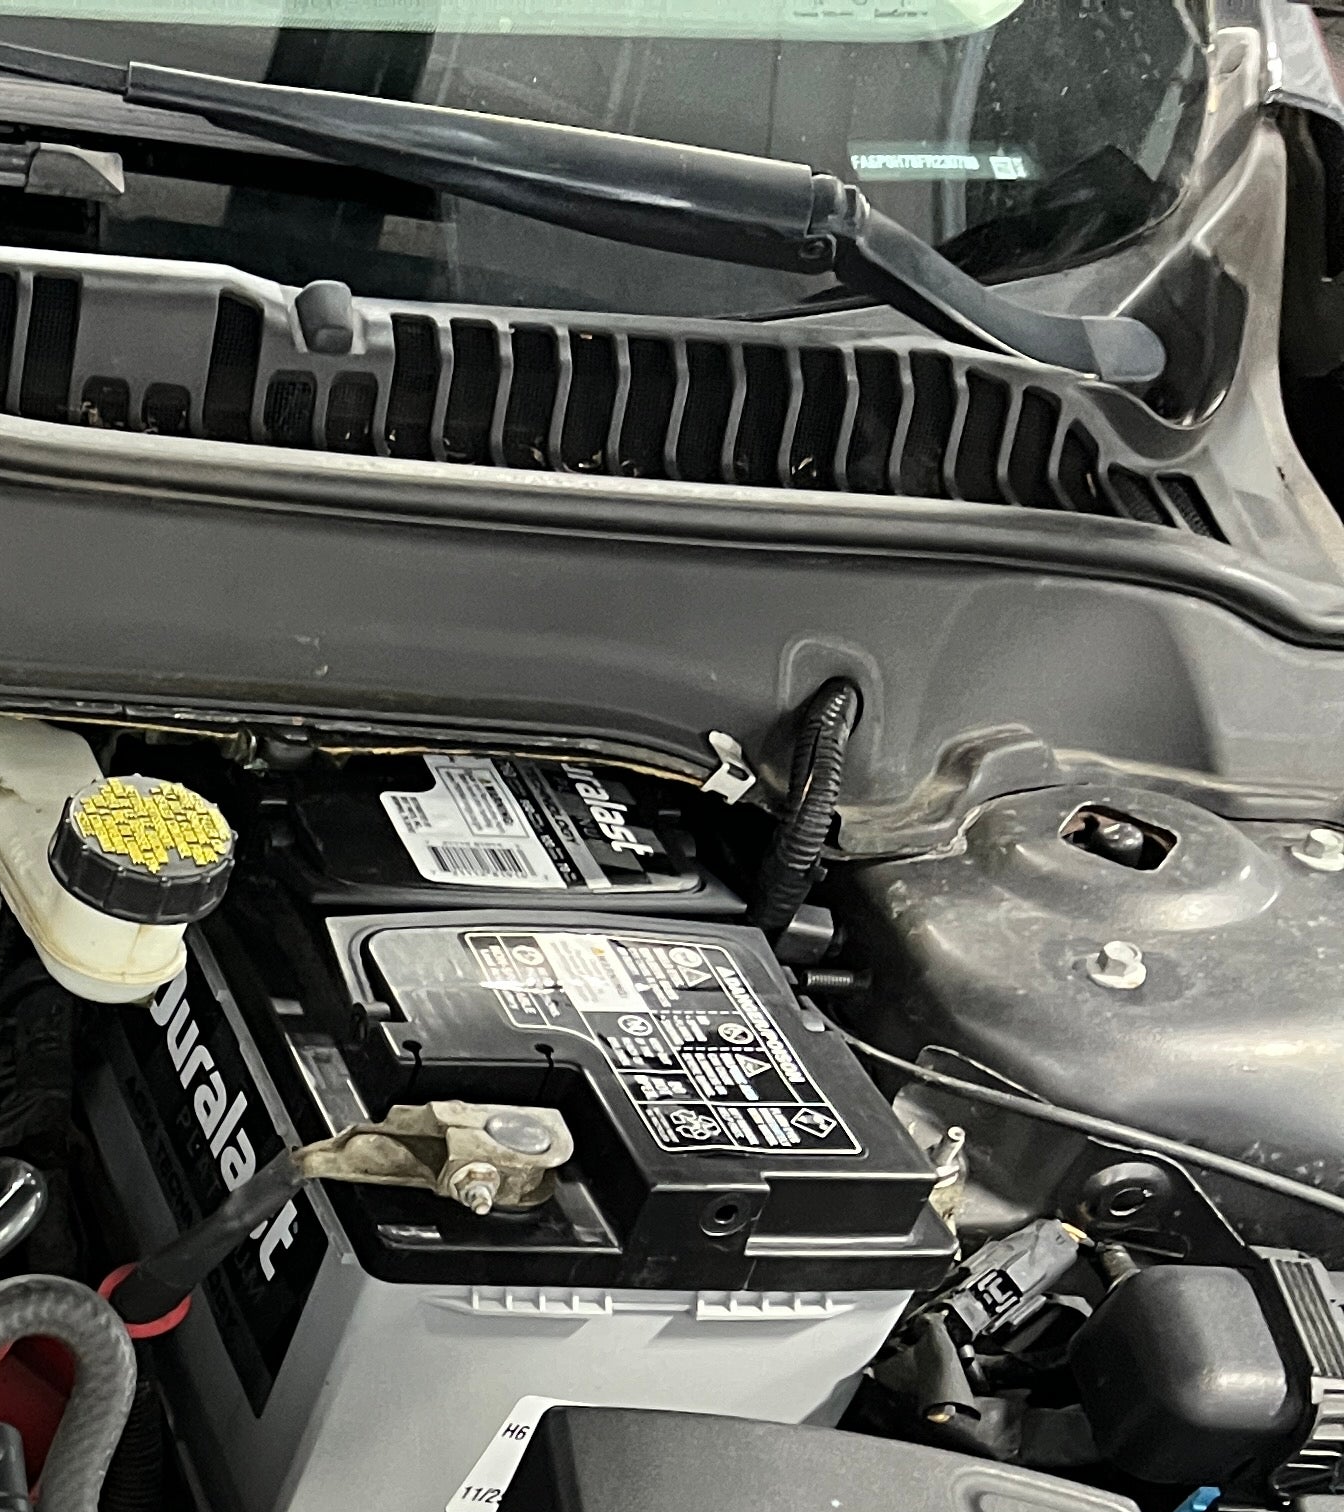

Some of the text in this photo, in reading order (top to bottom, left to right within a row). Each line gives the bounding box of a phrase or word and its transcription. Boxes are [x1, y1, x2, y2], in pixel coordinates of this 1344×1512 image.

[561, 762, 654, 858] uralast
[501, 1423, 530, 1441] H6
[461, 1486, 502, 1503] 11/2
